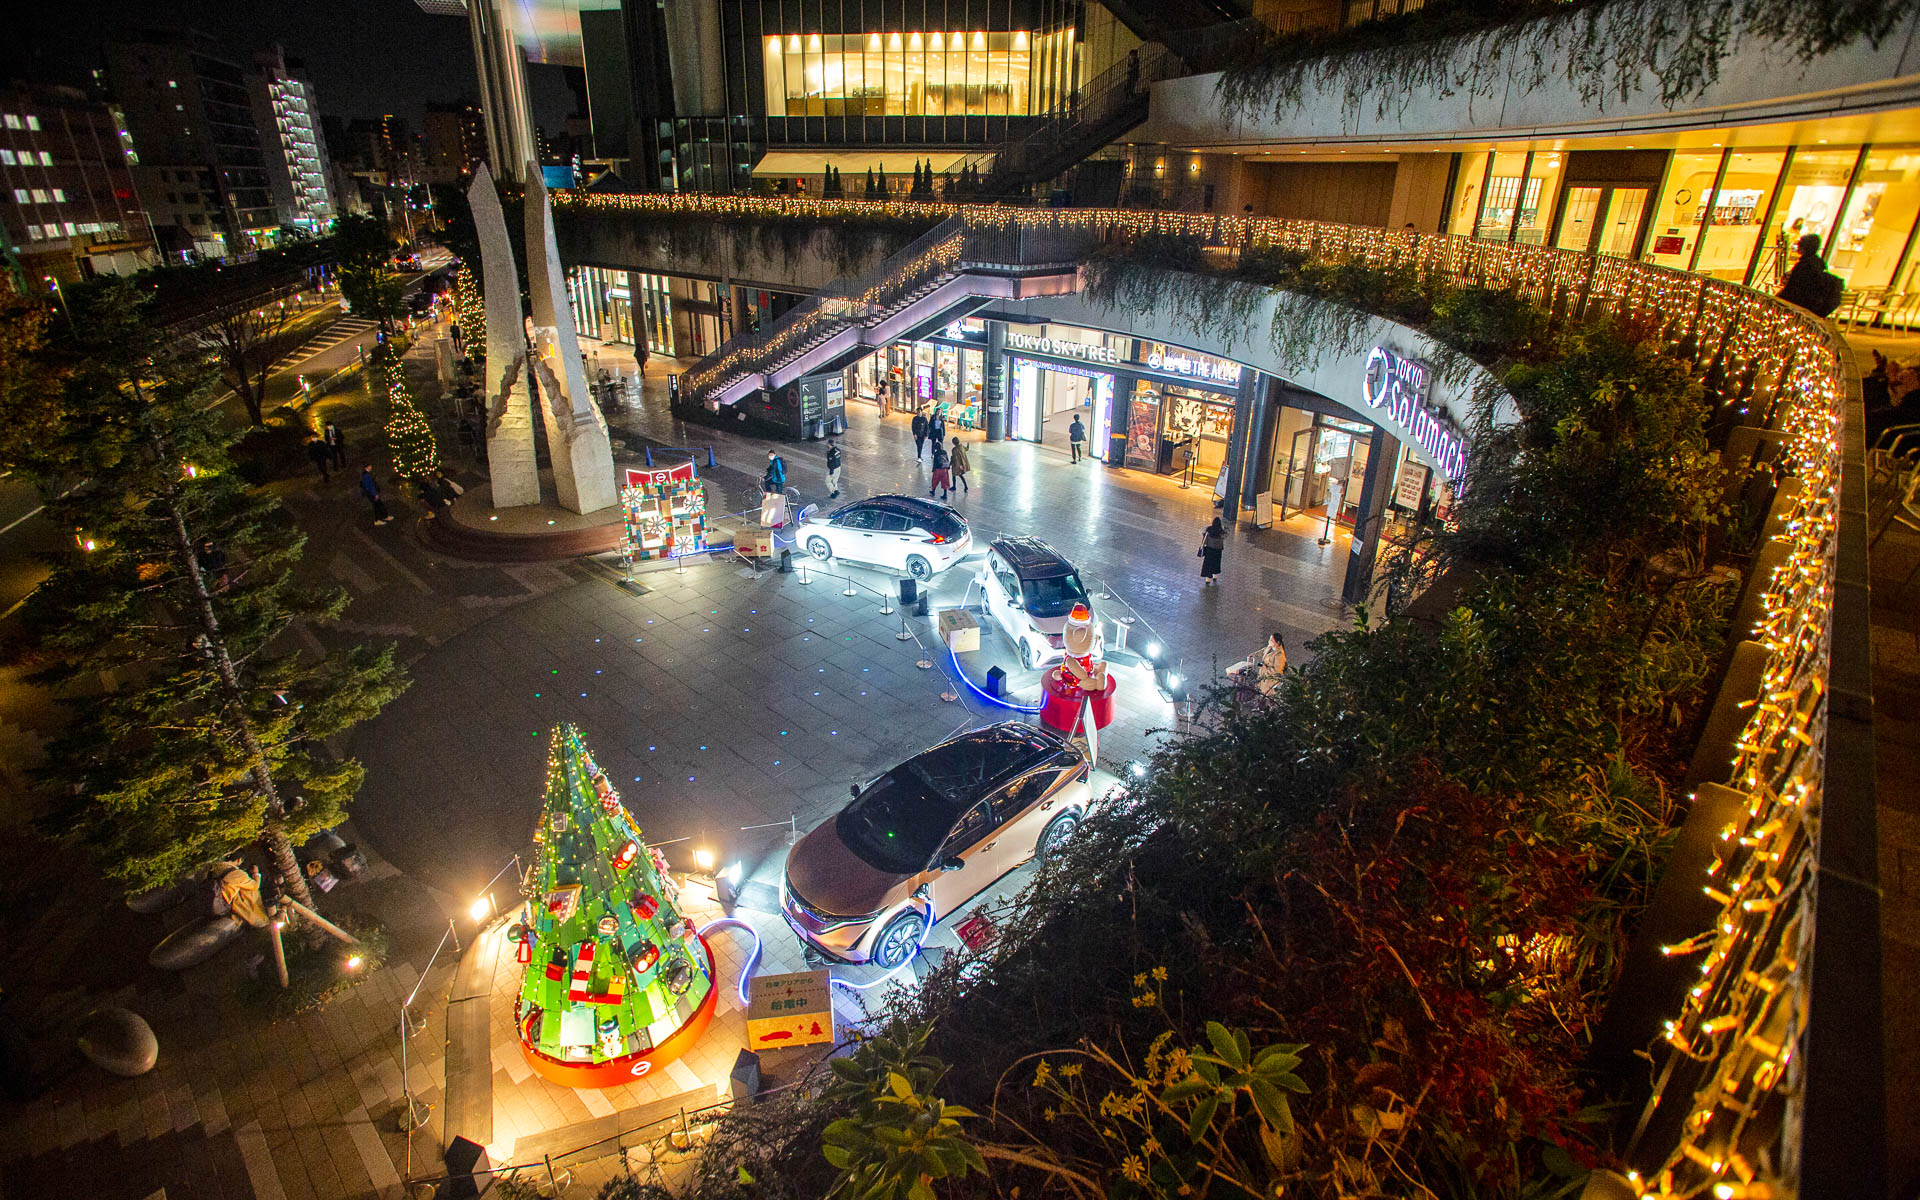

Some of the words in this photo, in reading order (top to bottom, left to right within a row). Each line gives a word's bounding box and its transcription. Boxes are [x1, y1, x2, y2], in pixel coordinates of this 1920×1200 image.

[1008, 333, 1050, 352] TOKYO
[1192, 360, 1210, 378] THE
[1211, 364, 1240, 382] ALLEY
[1396, 357, 1424, 389] TOKYO
